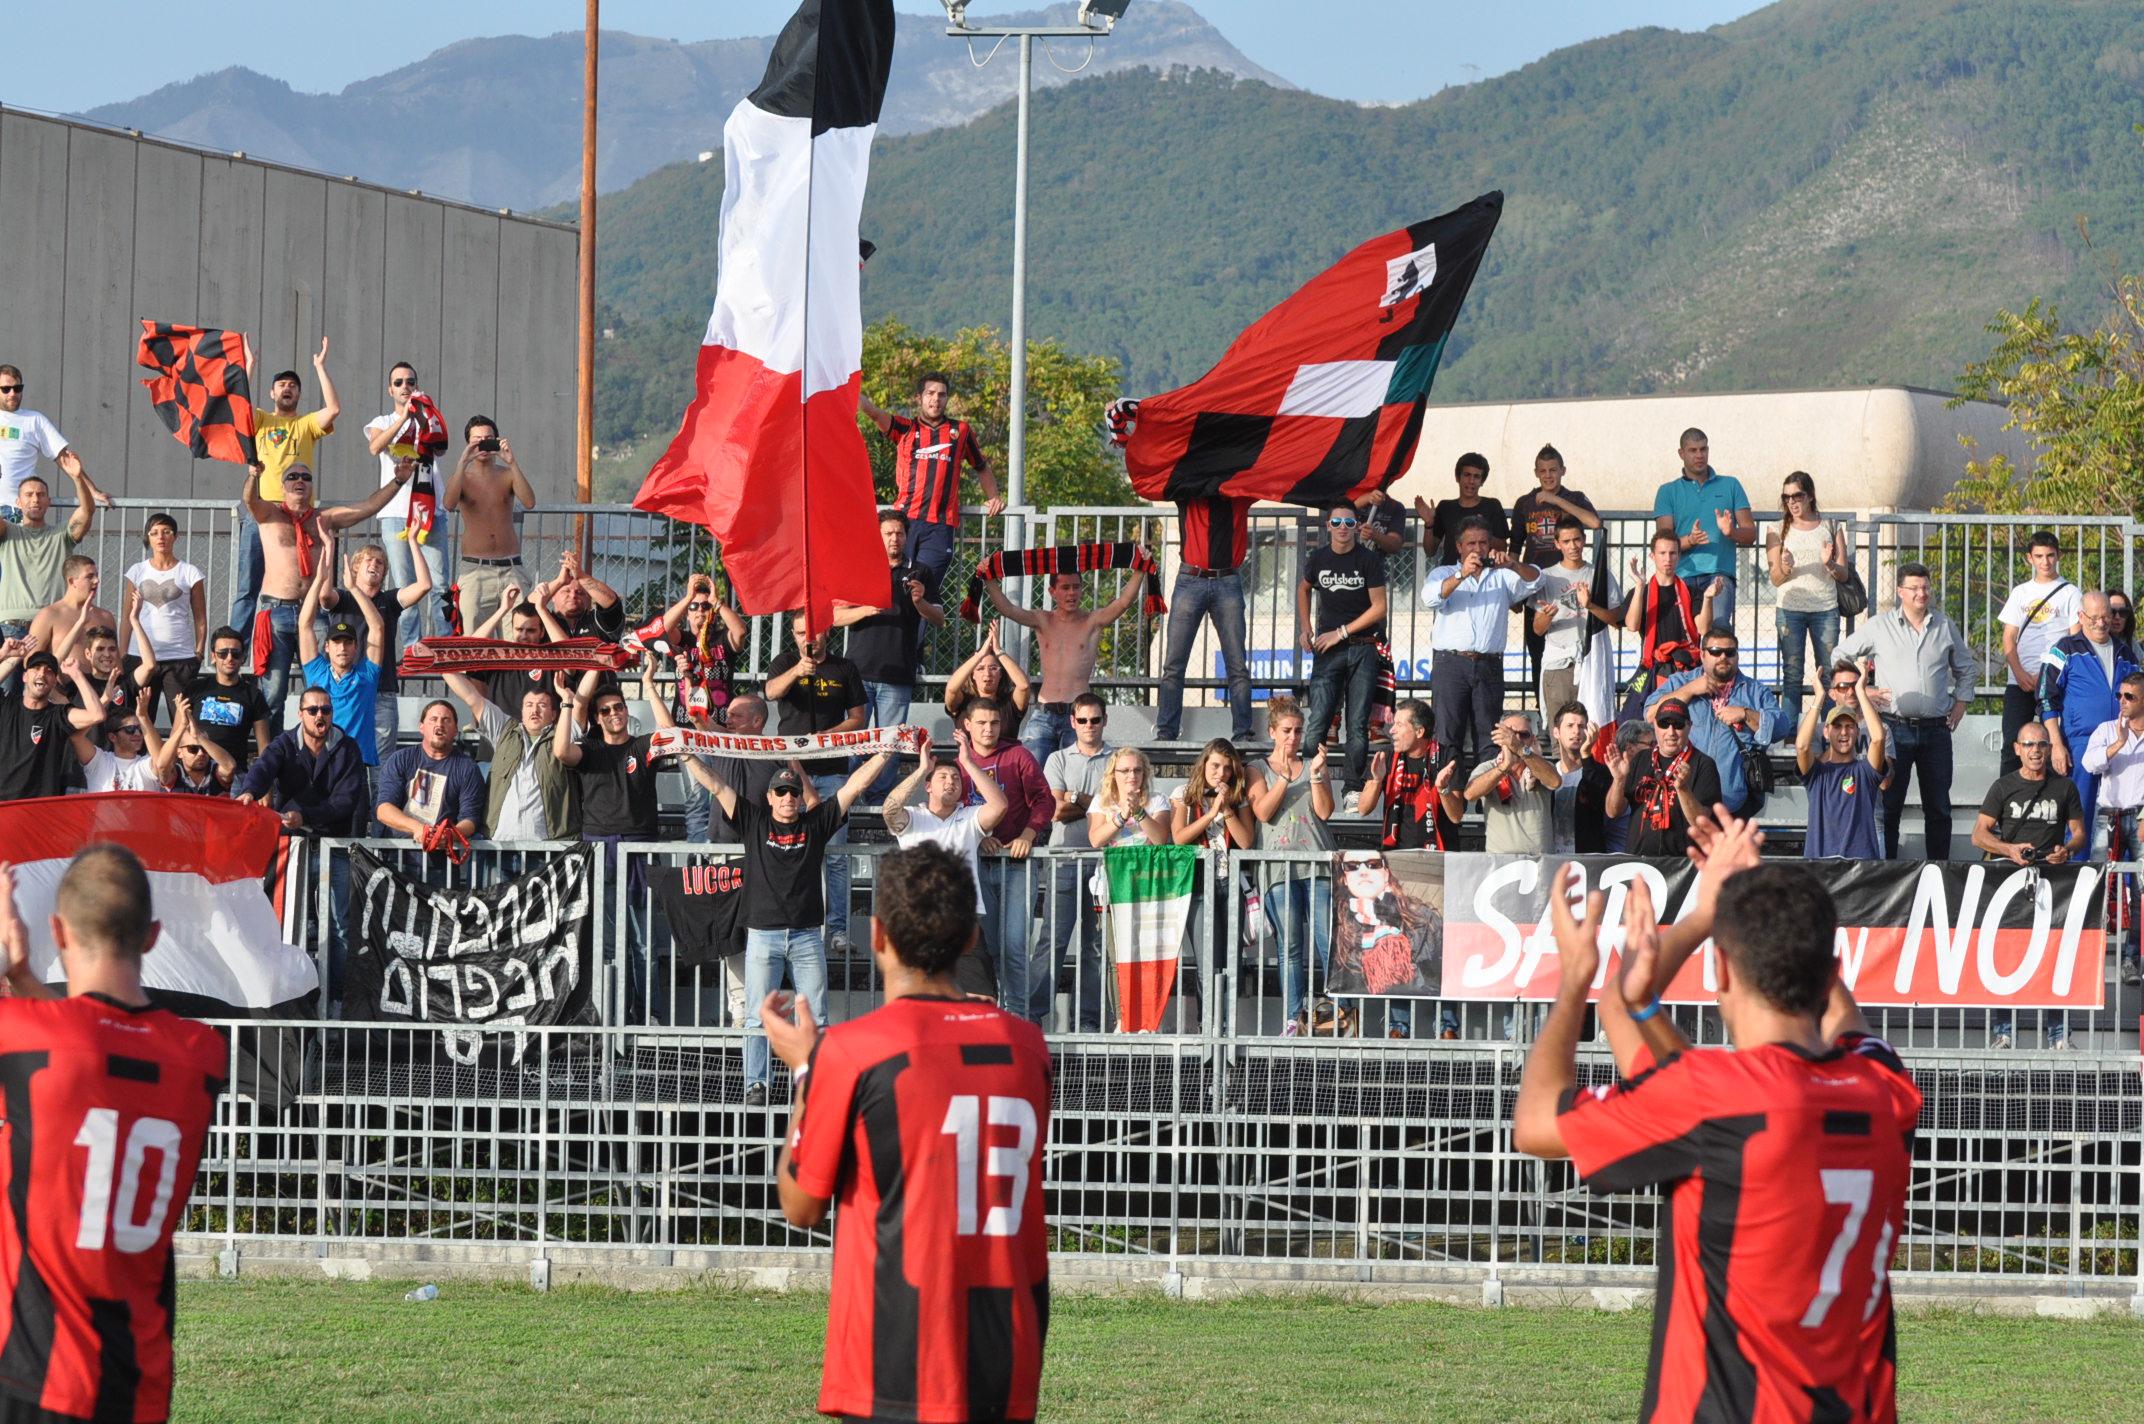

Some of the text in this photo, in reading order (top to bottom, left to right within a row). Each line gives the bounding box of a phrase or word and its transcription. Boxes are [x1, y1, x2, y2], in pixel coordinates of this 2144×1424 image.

[1318, 569, 1365, 588] Carlsberg
[434, 648, 501, 661] FORZA
[681, 729, 787, 751] PANTHERS
[816, 727, 884, 748] FRONT
[1894, 863, 2100, 997] NOI
[74, 1106, 182, 1254] 10
[940, 1094, 1038, 1237] 13
